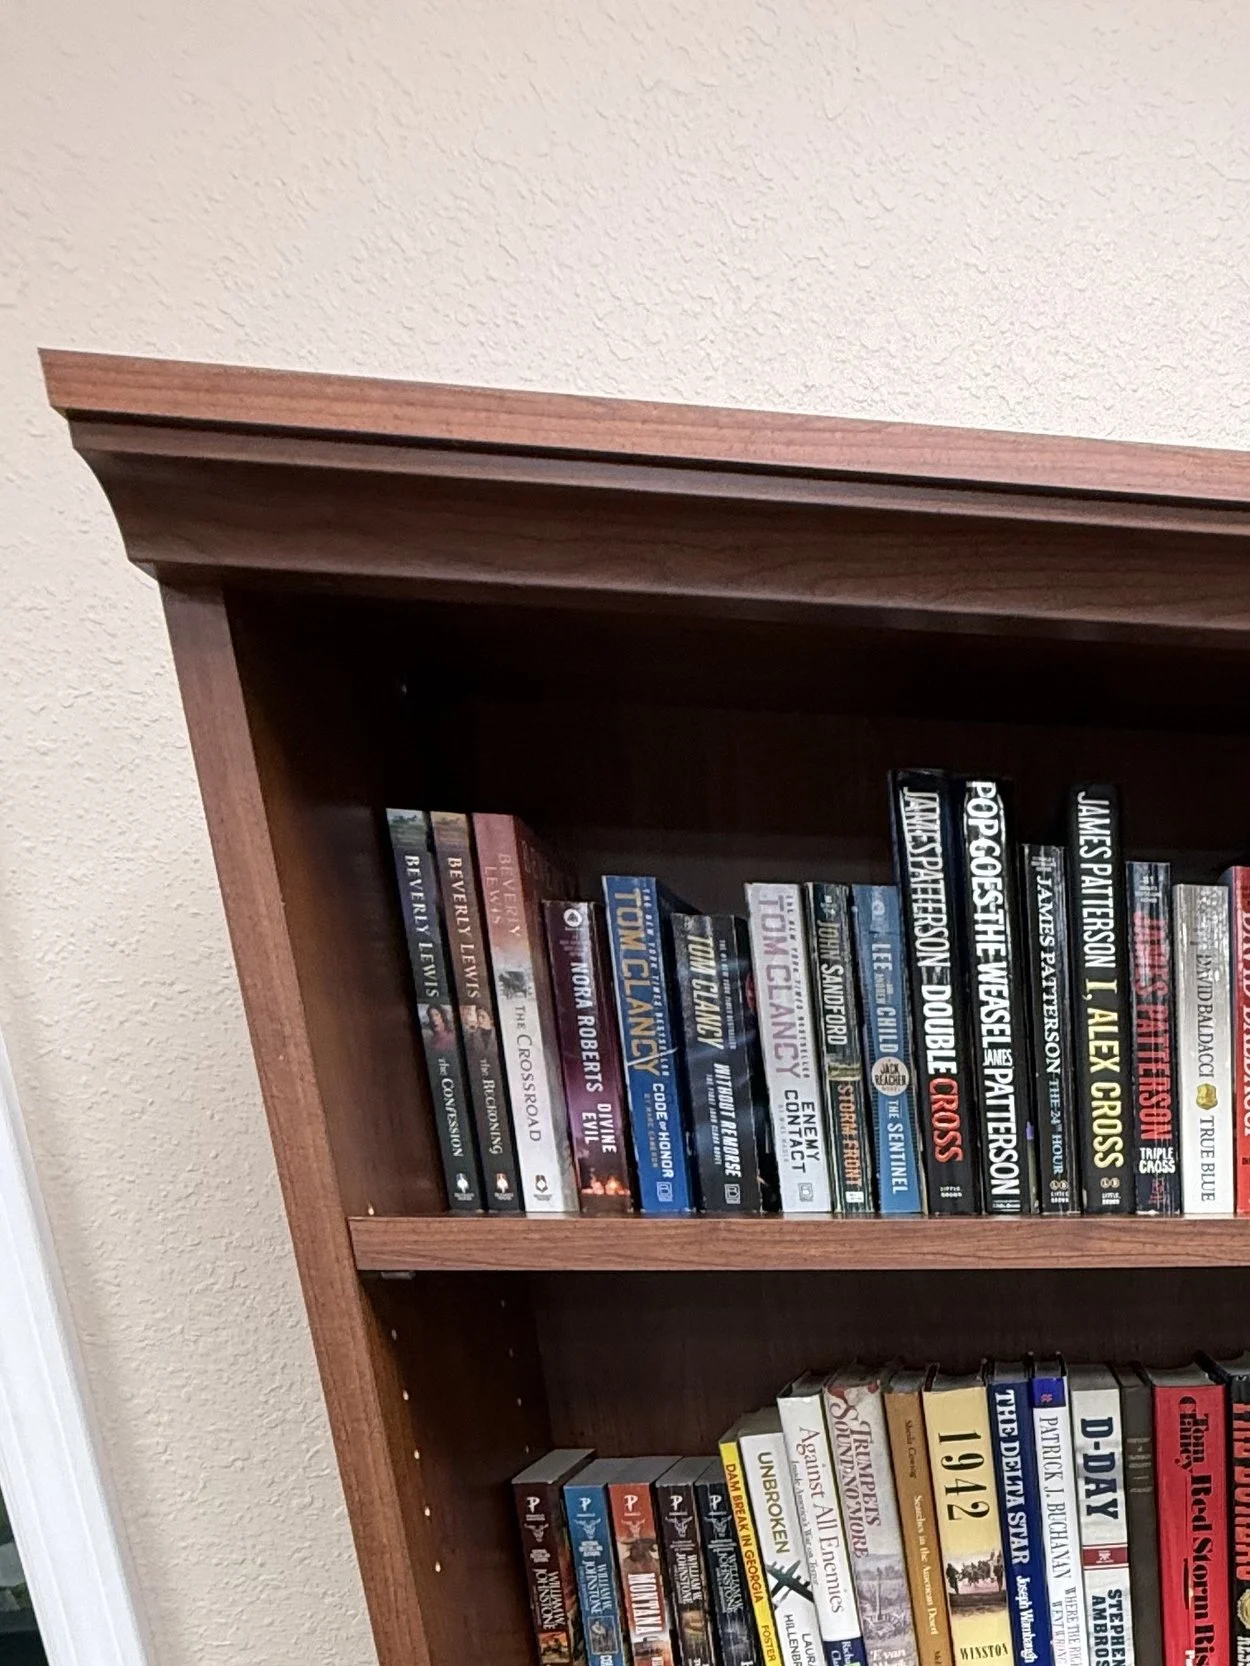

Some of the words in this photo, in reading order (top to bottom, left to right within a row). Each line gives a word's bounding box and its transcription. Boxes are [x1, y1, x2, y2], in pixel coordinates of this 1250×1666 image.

[966, 781, 999, 836] POP
[969, 838, 1003, 906] GOES
[405, 855, 429, 936] BEVERLY
[419, 942, 439, 997] LEWIS
[448, 857, 471, 936] BEVERLY
[461, 944, 480, 998] LEWIS
[614, 887, 645, 950] TOM
[759, 895, 789, 957] TOM
[974, 908, 1007, 958] THE
[1080, 864, 1117, 968] PATTERSON
[687, 935, 717, 975] TOM
[622, 961, 660, 1076] CLANCY
[691, 978, 724, 1049] CLANCY
[766, 963, 800, 1078] CLANCY
[821, 964, 847, 1046] SANDFORD
[922, 984, 957, 1075] DOUBLE
[978, 961, 1014, 1049] WEASEL
[1041, 951, 1061, 1074] PATTERSON
[578, 1015, 603, 1092] ROBERTS
[880, 1063, 899, 1074] JACK
[1086, 1007, 1120, 1073] ALEX
[875, 1074, 906, 1086] REACHER
[581, 1112, 599, 1144] EVIL
[597, 1103, 616, 1153] DIVINE
[784, 1090, 806, 1173] CONTACT
[801, 1101, 820, 1161] ENEMY
[929, 1077, 964, 1164] CROSS
[984, 1068, 1020, 1196] PATTERSON
[1090, 1082, 1124, 1168] CROSS
[1139, 1147, 1173, 1159] TRIPLE
[1200, 1115, 1215, 1159] TRUE
[887, 1123, 908, 1195] SENTINEL
[1139, 1160, 1175, 1174] CROSS
[1201, 1162, 1215, 1202] BLUE
[995, 1390, 1018, 1438] THE
[796, 1426, 825, 1499] Against
[813, 1504, 838, 1530] All
[1040, 1417, 1064, 1483] PATRICK
[1081, 1417, 1118, 1519] D-DAY
[757, 1452, 790, 1553] UNBROKEN
[732, 1495, 747, 1531] BREAK
[745, 1550, 764, 1603] GEORGIA
[1006, 1512, 1029, 1565] STAR
[761, 1625, 776, 1662] FOSTER
[960, 1643, 1008, 1661] WINSTON
